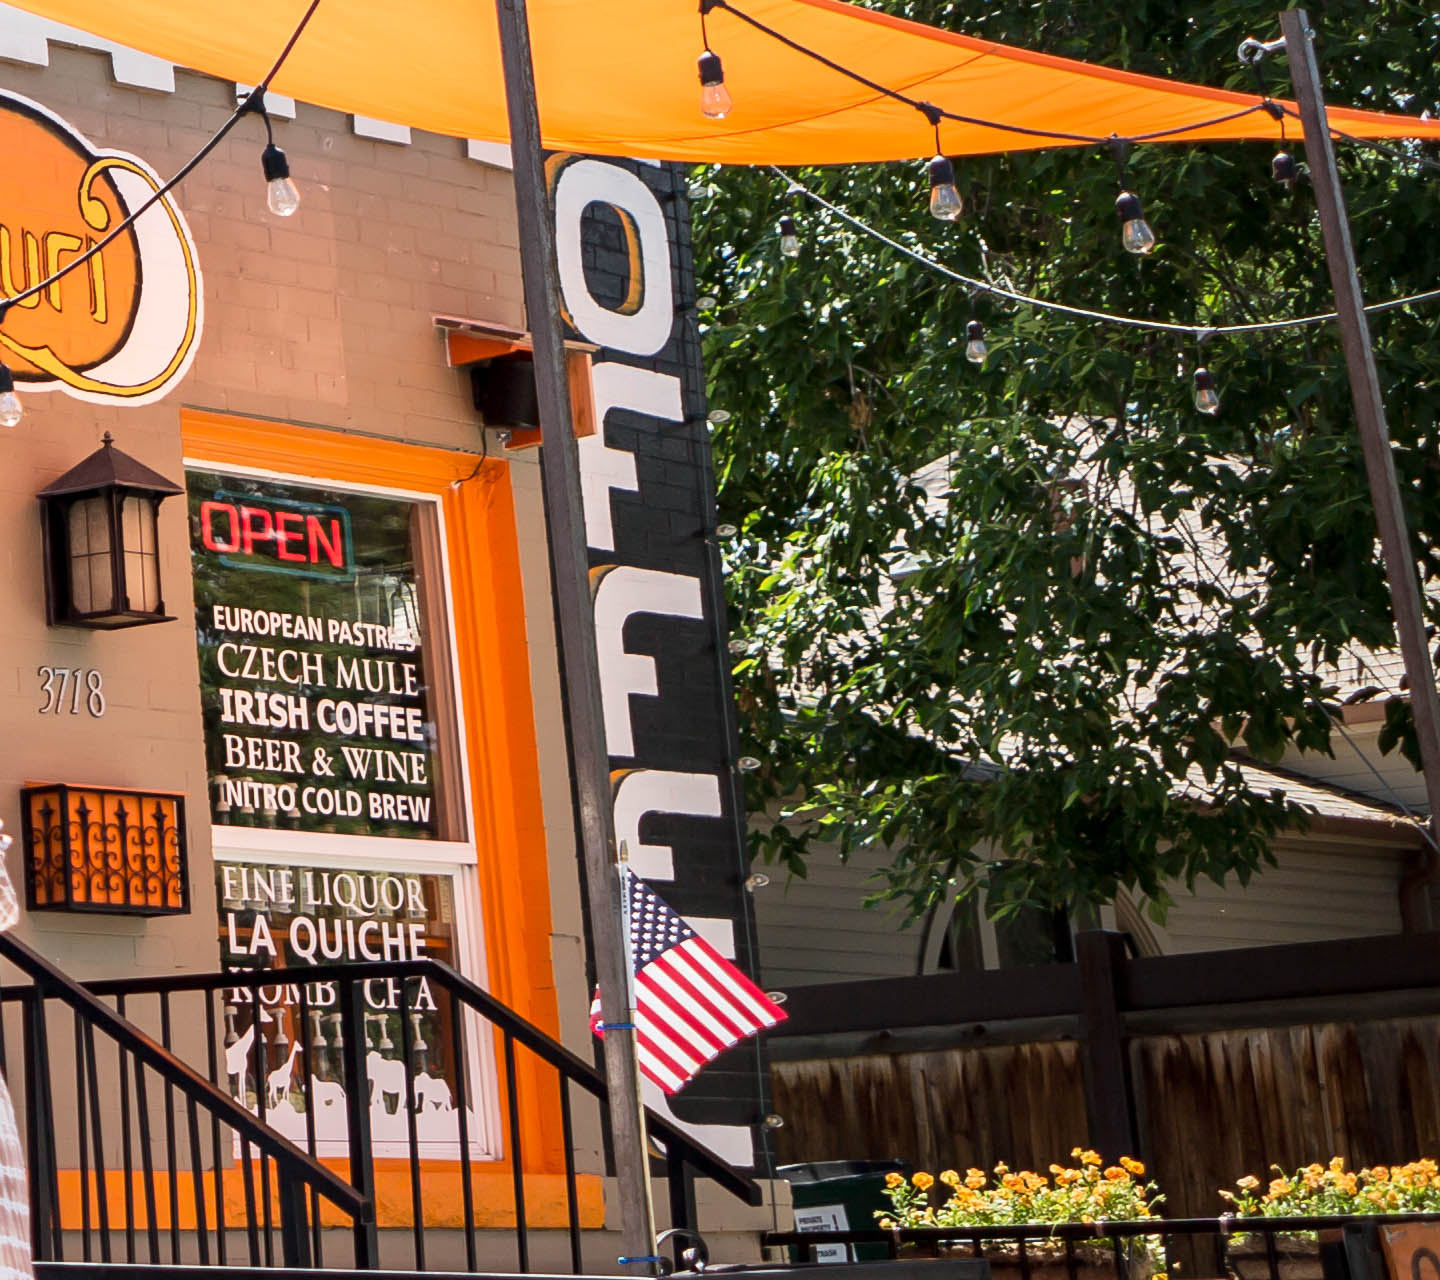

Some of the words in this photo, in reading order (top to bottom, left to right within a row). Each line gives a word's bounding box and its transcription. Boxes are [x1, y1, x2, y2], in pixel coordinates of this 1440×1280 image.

[200, 501, 344, 568] OPEN
[213, 605, 323, 642] EUROPEAN
[328, 619, 416, 652] PASTRIES
[37, 665, 105, 718] 3718
[217, 643, 326, 687] CZECH
[336, 656, 419, 697] MULE
[219, 688, 309, 730] IRISH
[316, 699, 423, 741] COFFEE
[223, 734, 305, 774] BEER
[312, 747, 335, 776] &
[341, 746, 428, 785] WINE
[225, 779, 295, 811] NITRO
[302, 786, 362, 817] COLD
[368, 792, 430, 823] BREW
[221, 866, 295, 904] FINE
[304, 871, 428, 917] LIQUOR
[227, 913, 277, 956] LA
[289, 915, 433, 965] QUICHE
